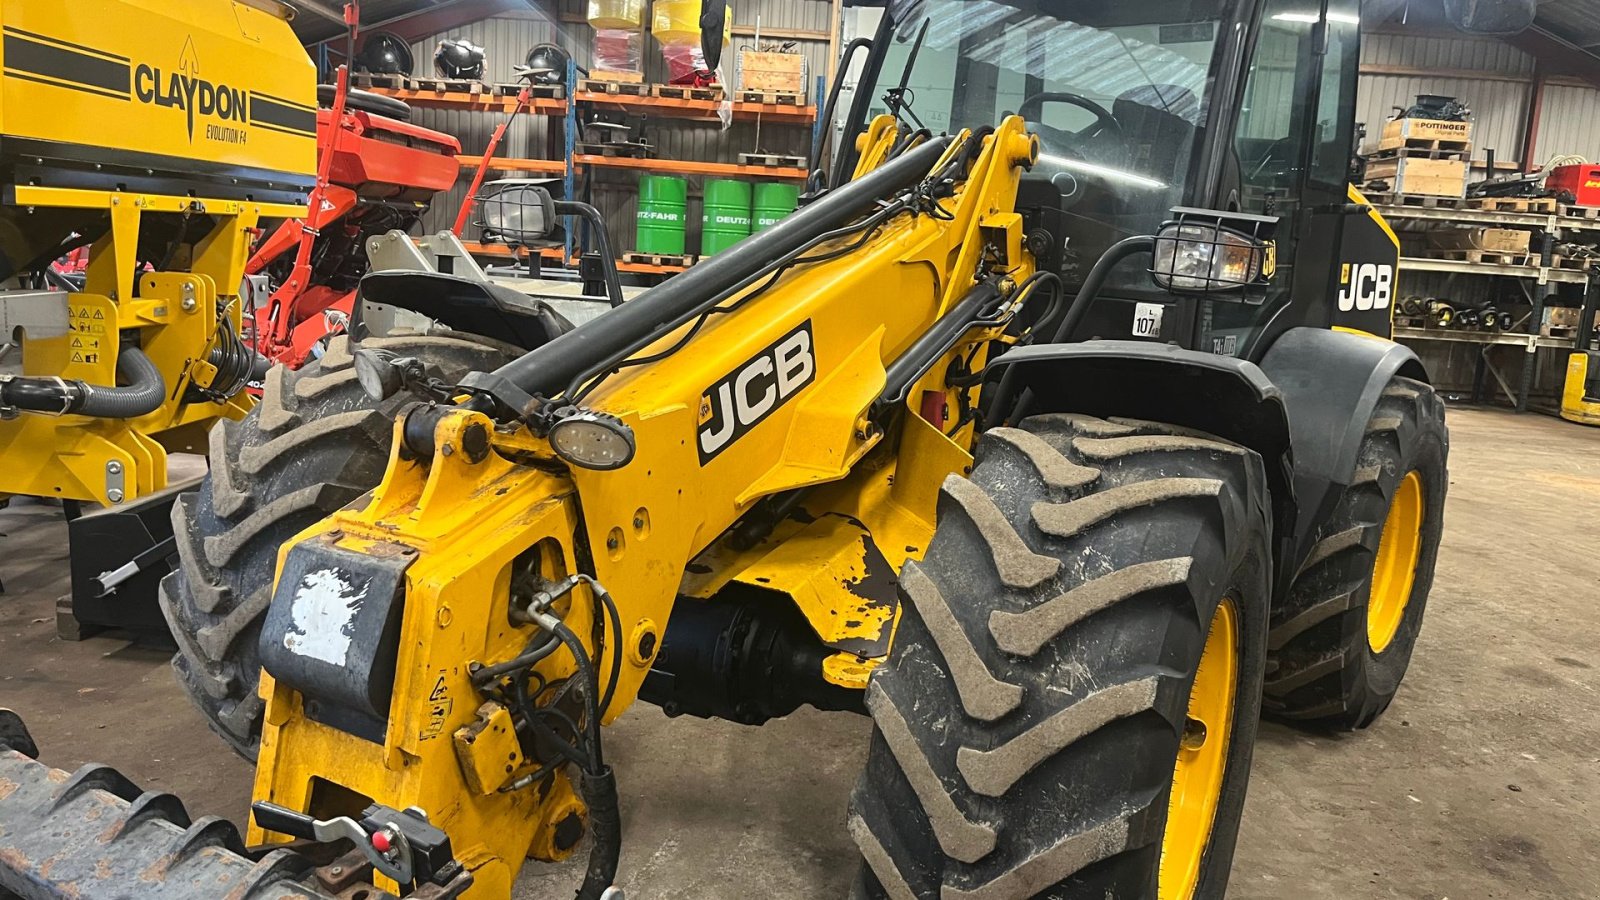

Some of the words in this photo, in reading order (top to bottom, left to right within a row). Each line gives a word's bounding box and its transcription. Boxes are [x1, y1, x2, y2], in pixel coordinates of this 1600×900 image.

[135, 63, 246, 144] CLAYDON
[206, 124, 239, 144] EVOLUTION
[239, 130, 247, 145] F4
[1338, 263, 1392, 312] JCB
[1136, 317, 1155, 334] 107
[700, 329, 813, 454] JCB
